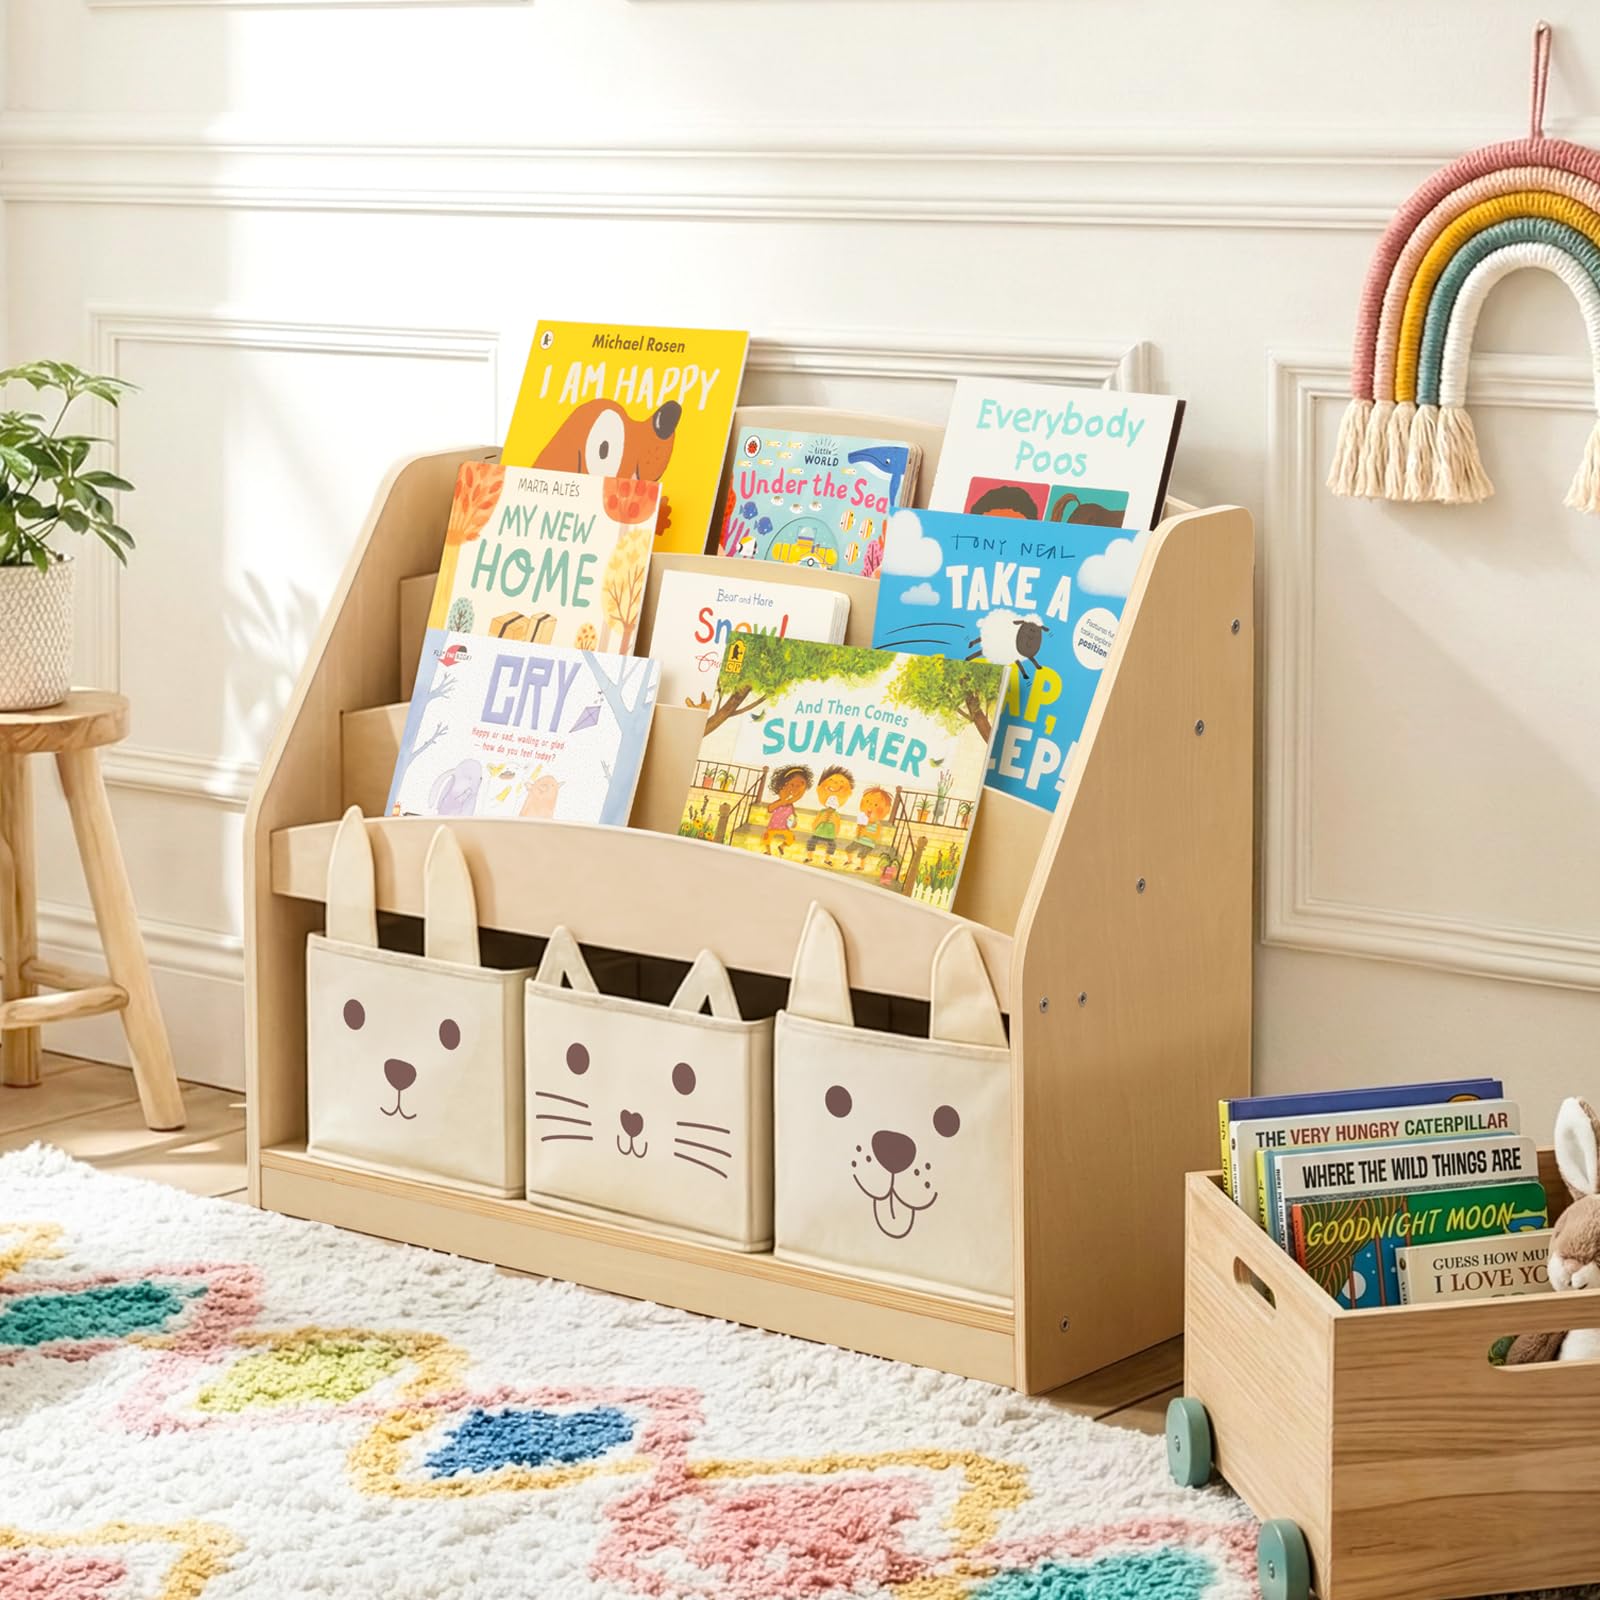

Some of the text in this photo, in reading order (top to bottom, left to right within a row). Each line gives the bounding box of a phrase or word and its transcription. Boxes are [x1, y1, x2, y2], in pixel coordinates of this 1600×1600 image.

[592, 333, 685, 354] Michael Rosen
[539, 361, 720, 411] I AM HAPPY
[976, 398, 1145, 447] Everybody
[804, 455, 839, 467] WORLD
[1015, 440, 1087, 477] Poos
[518, 477, 581, 498] MARTA ALTÉS
[740, 468, 888, 513] Under the Sea
[498, 504, 597, 544] MY NEW
[952, 533, 1076, 560] TONY NEAL
[470, 538, 598, 608] HOME
[716, 588, 774, 608] Bear and Hare
[946, 561, 1072, 622] TAKE A
[1078, 638, 1108, 658] position
[480, 654, 582, 733] CRY
[1001, 661, 1063, 735] AP,
[795, 698, 909, 729] And Then Comes
[471, 727, 490, 739] Happy
[518, 736, 540, 748] wailing
[482, 742, 556, 763] how do you feel today?
[762, 717, 927, 778] SUMMER
[1255, 1112, 1509, 1148] THE VERY HUNGRY CATERPILLAR
[1302, 1147, 1522, 1189] WHERE THE WILD THINGS ARE
[1307, 1208, 1442, 1247] GOODNIGHT
[1446, 1201, 1515, 1232] MOON
[1432, 1248, 1549, 1271] GUESS HOW MU
[1434, 1265, 1549, 1293] I LOVE YO
